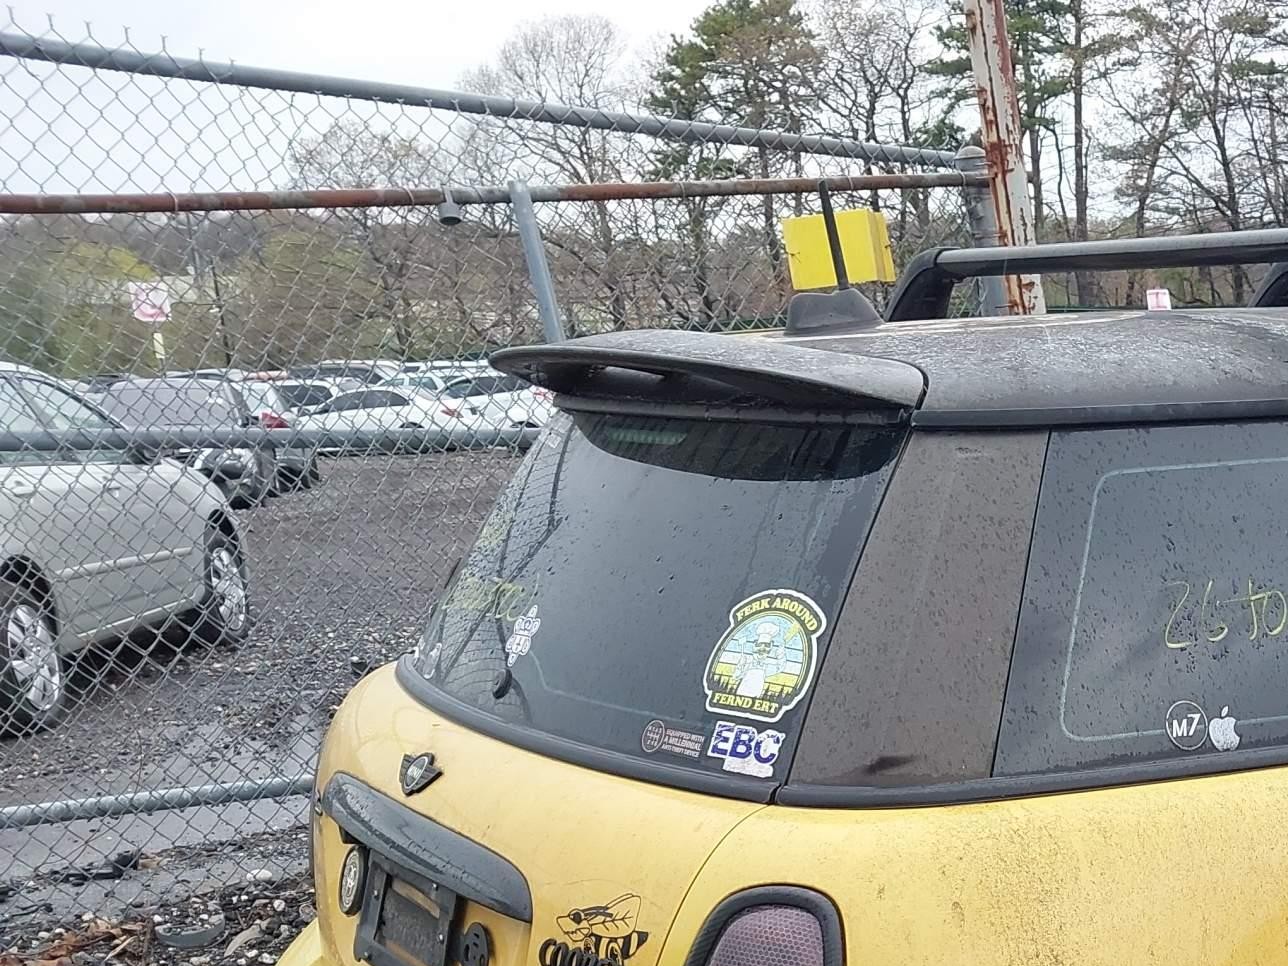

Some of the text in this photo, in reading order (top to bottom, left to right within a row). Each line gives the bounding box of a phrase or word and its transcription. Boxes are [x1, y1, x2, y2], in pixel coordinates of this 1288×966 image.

[735, 597, 818, 632] FERK AROUND
[713, 694, 779, 714] FERND ERT
[1172, 712, 1200, 738] M7
[711, 722, 784, 764] EBC
